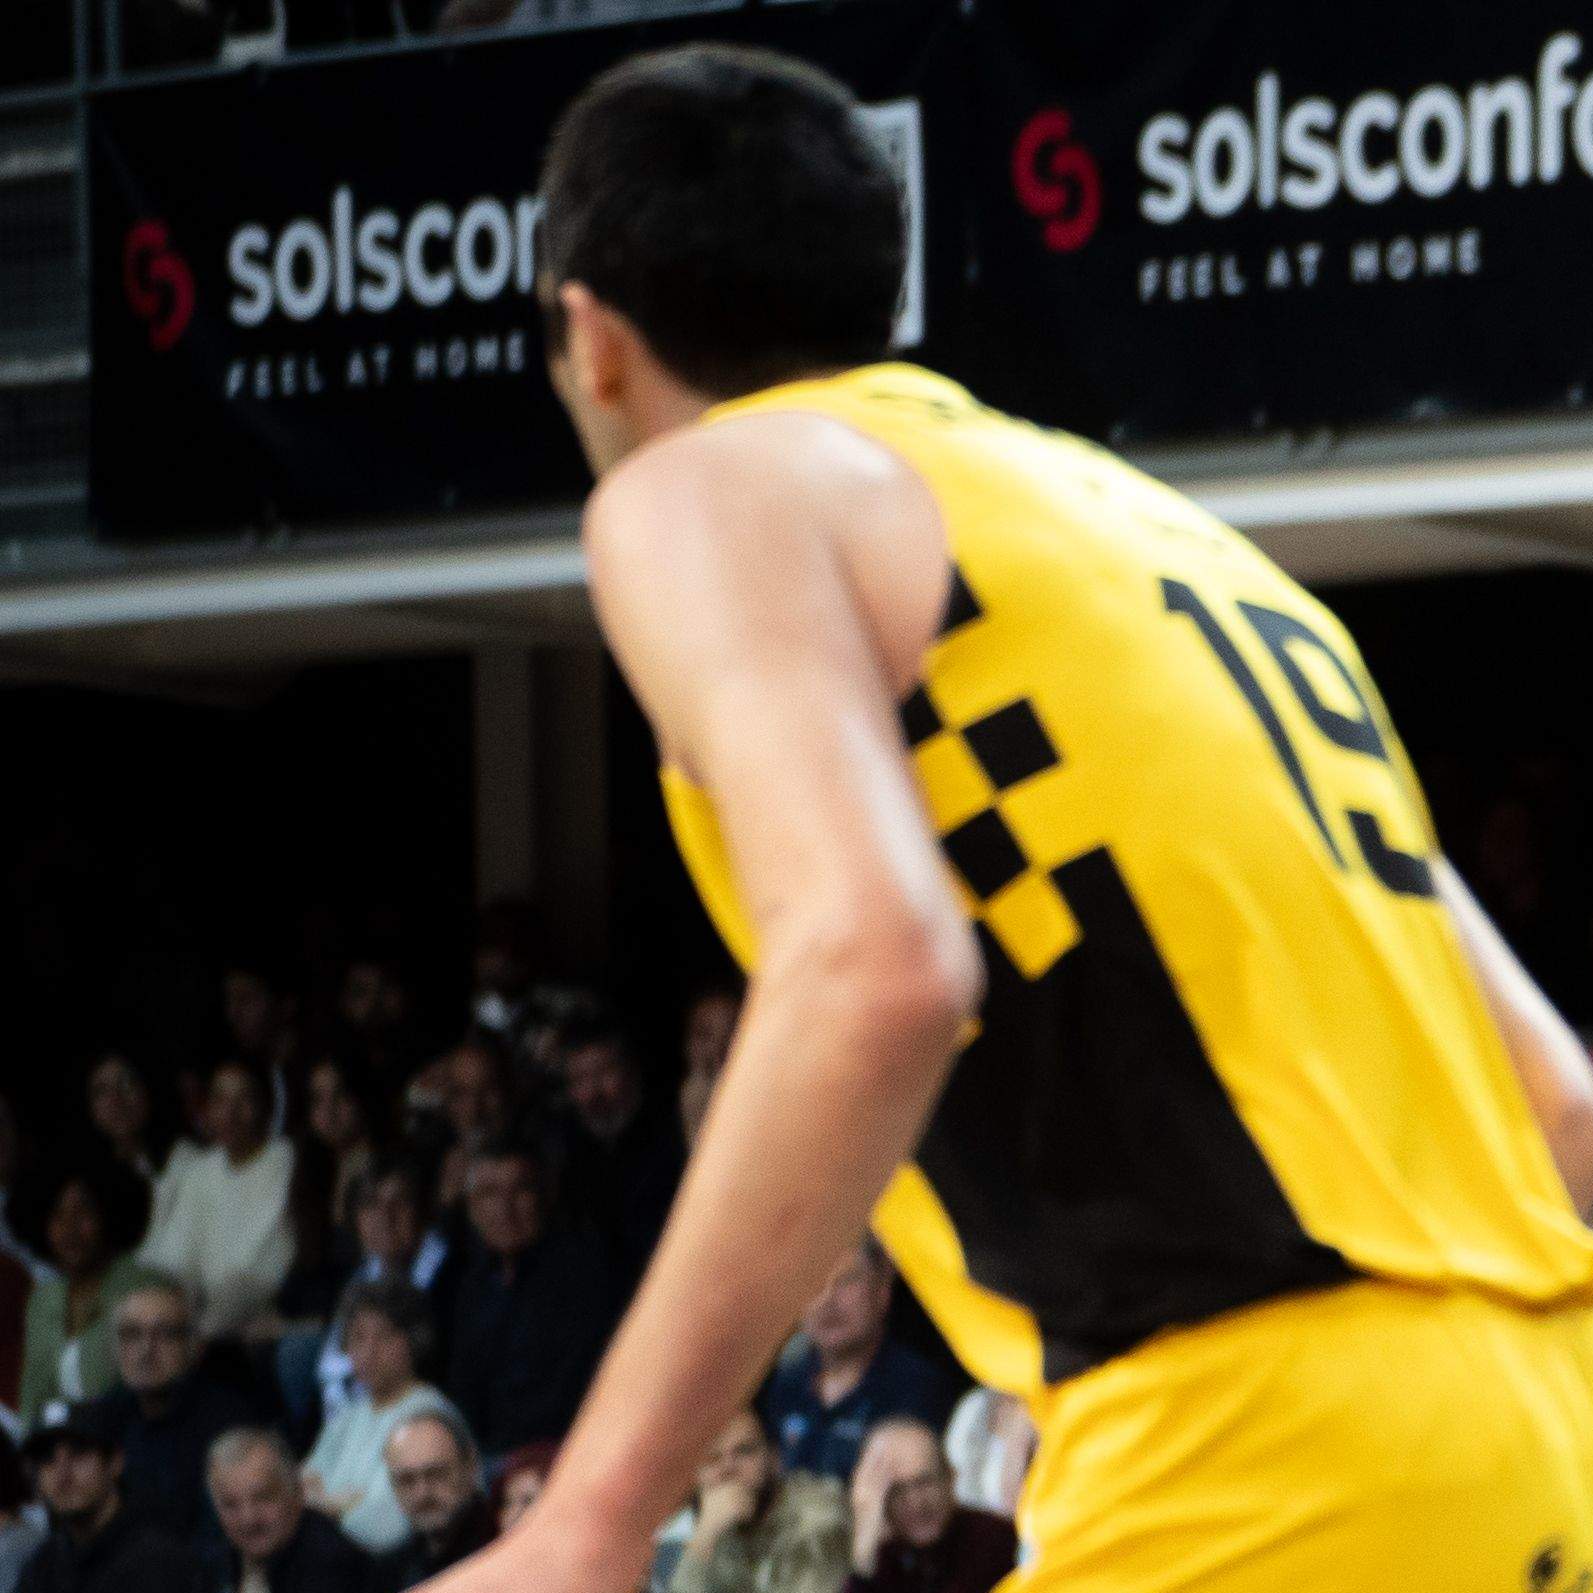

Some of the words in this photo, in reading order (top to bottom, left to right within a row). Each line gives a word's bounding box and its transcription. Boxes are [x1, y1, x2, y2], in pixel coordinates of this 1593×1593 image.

[1140, 256, 1246, 302] FEEL
[1267, 244, 1325, 289] AT
[1353, 228, 1483, 282] HOME
[225, 356, 323, 399] FEEL
[346, 348, 389, 388] AT
[414, 333, 526, 380] HOME
[1159, 577, 1440, 901] 19
